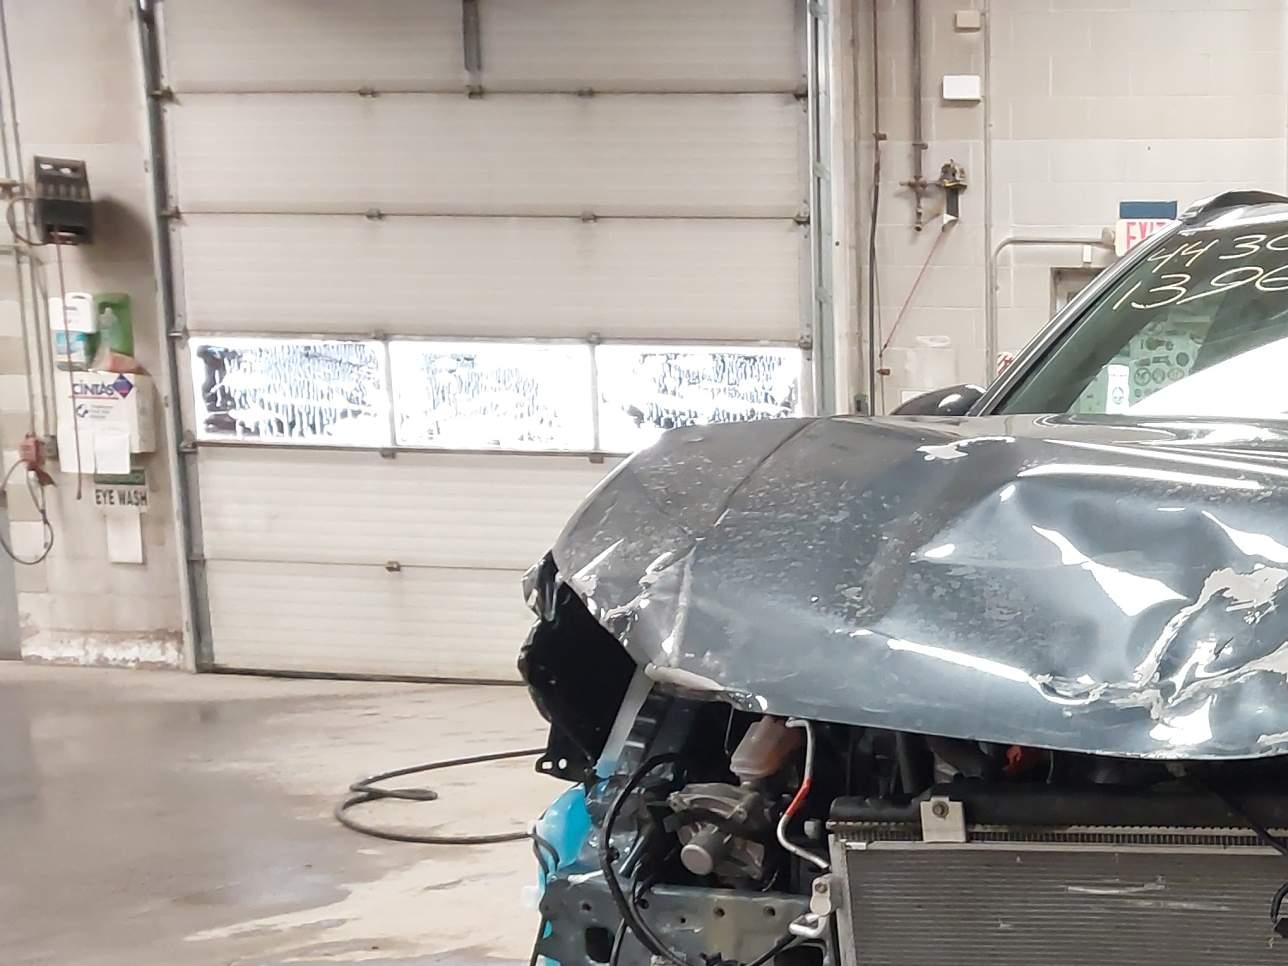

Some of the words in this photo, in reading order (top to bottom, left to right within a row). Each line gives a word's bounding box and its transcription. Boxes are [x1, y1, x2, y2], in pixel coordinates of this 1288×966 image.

[1126, 221, 1166, 250] EX
[95, 489, 114, 505] EYE
[117, 489, 148, 506] WASH
